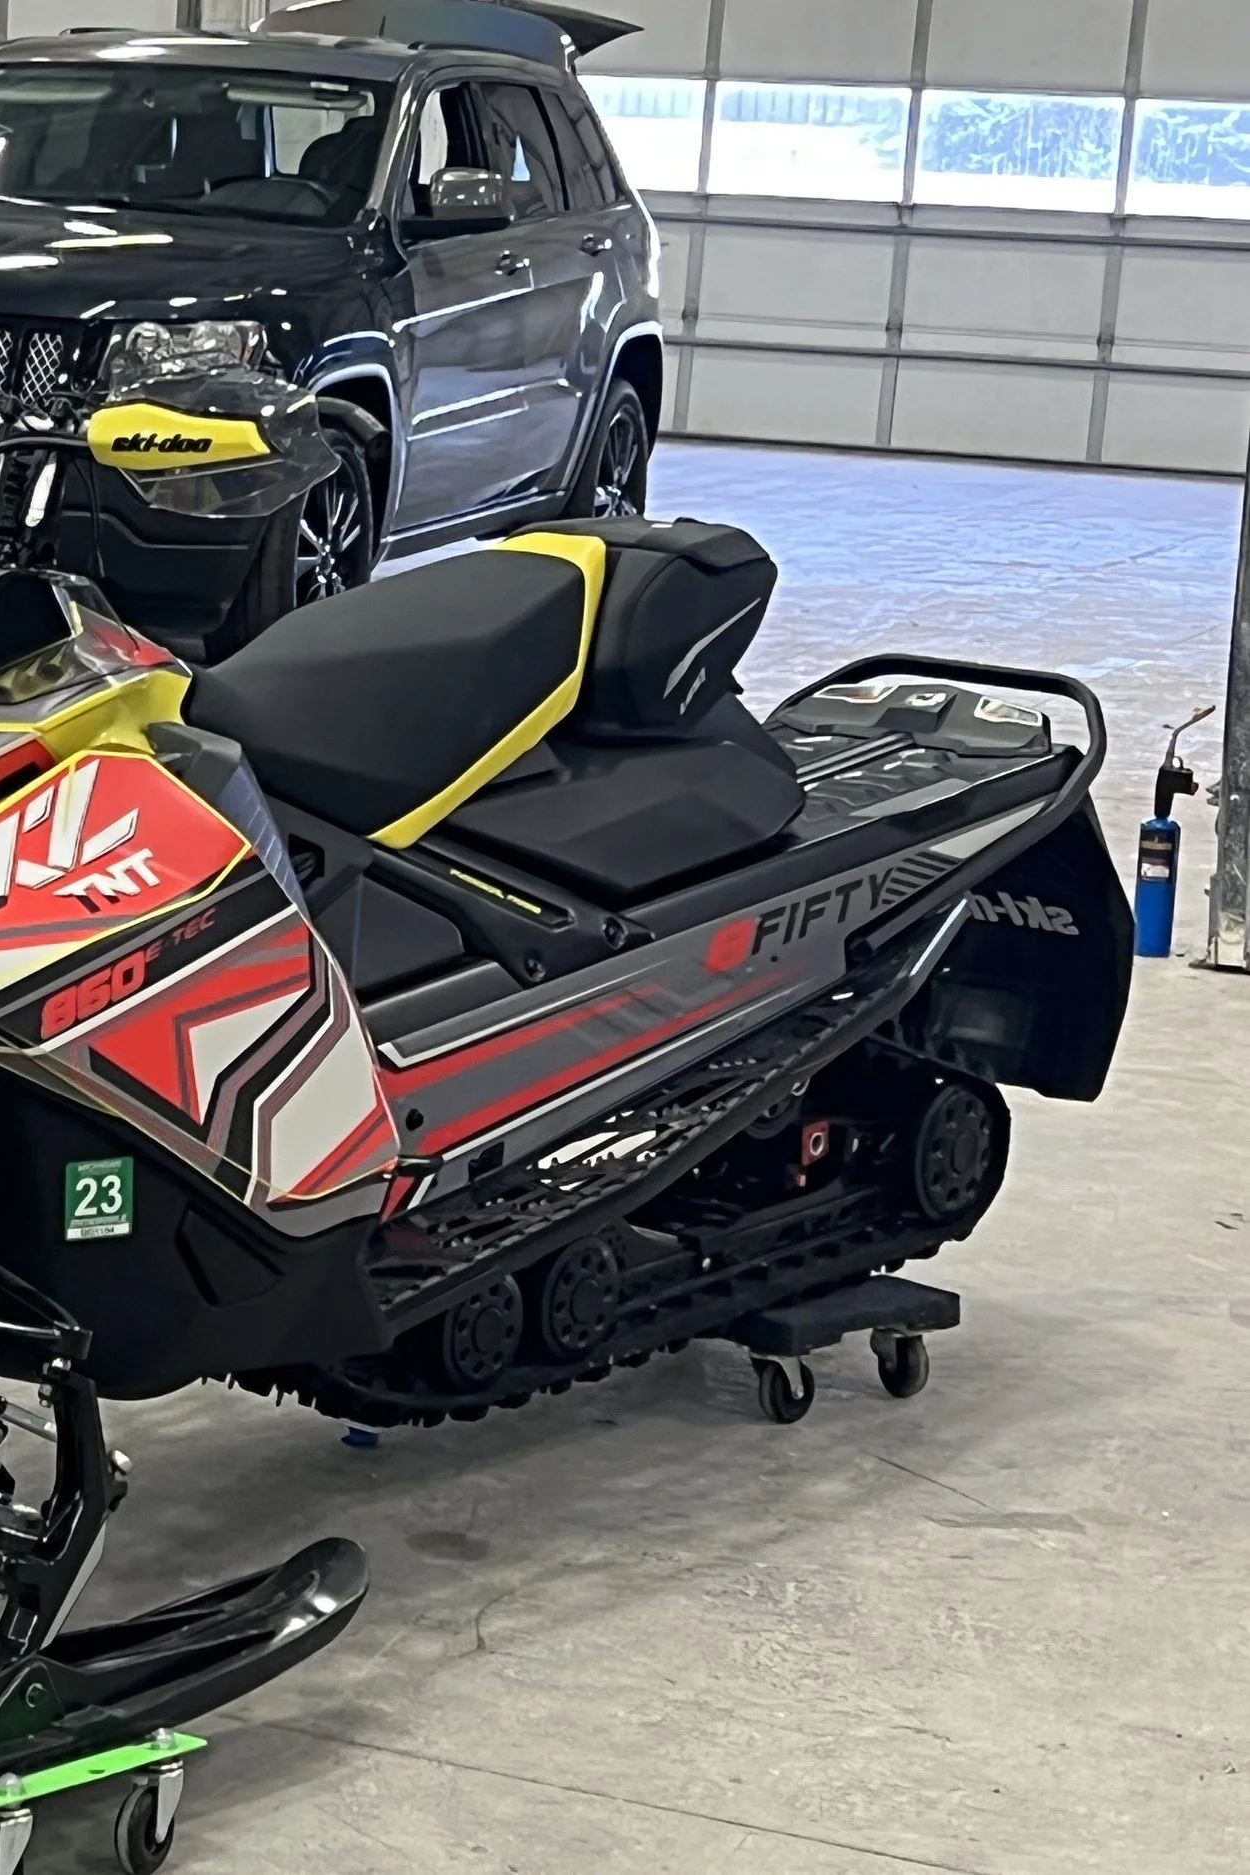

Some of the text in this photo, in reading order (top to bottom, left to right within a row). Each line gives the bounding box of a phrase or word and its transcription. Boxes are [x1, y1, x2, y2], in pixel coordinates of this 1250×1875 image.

[111, 432, 214, 453] ski-doo
[52, 847, 162, 914] TNT
[74, 1174, 124, 1217] 23
